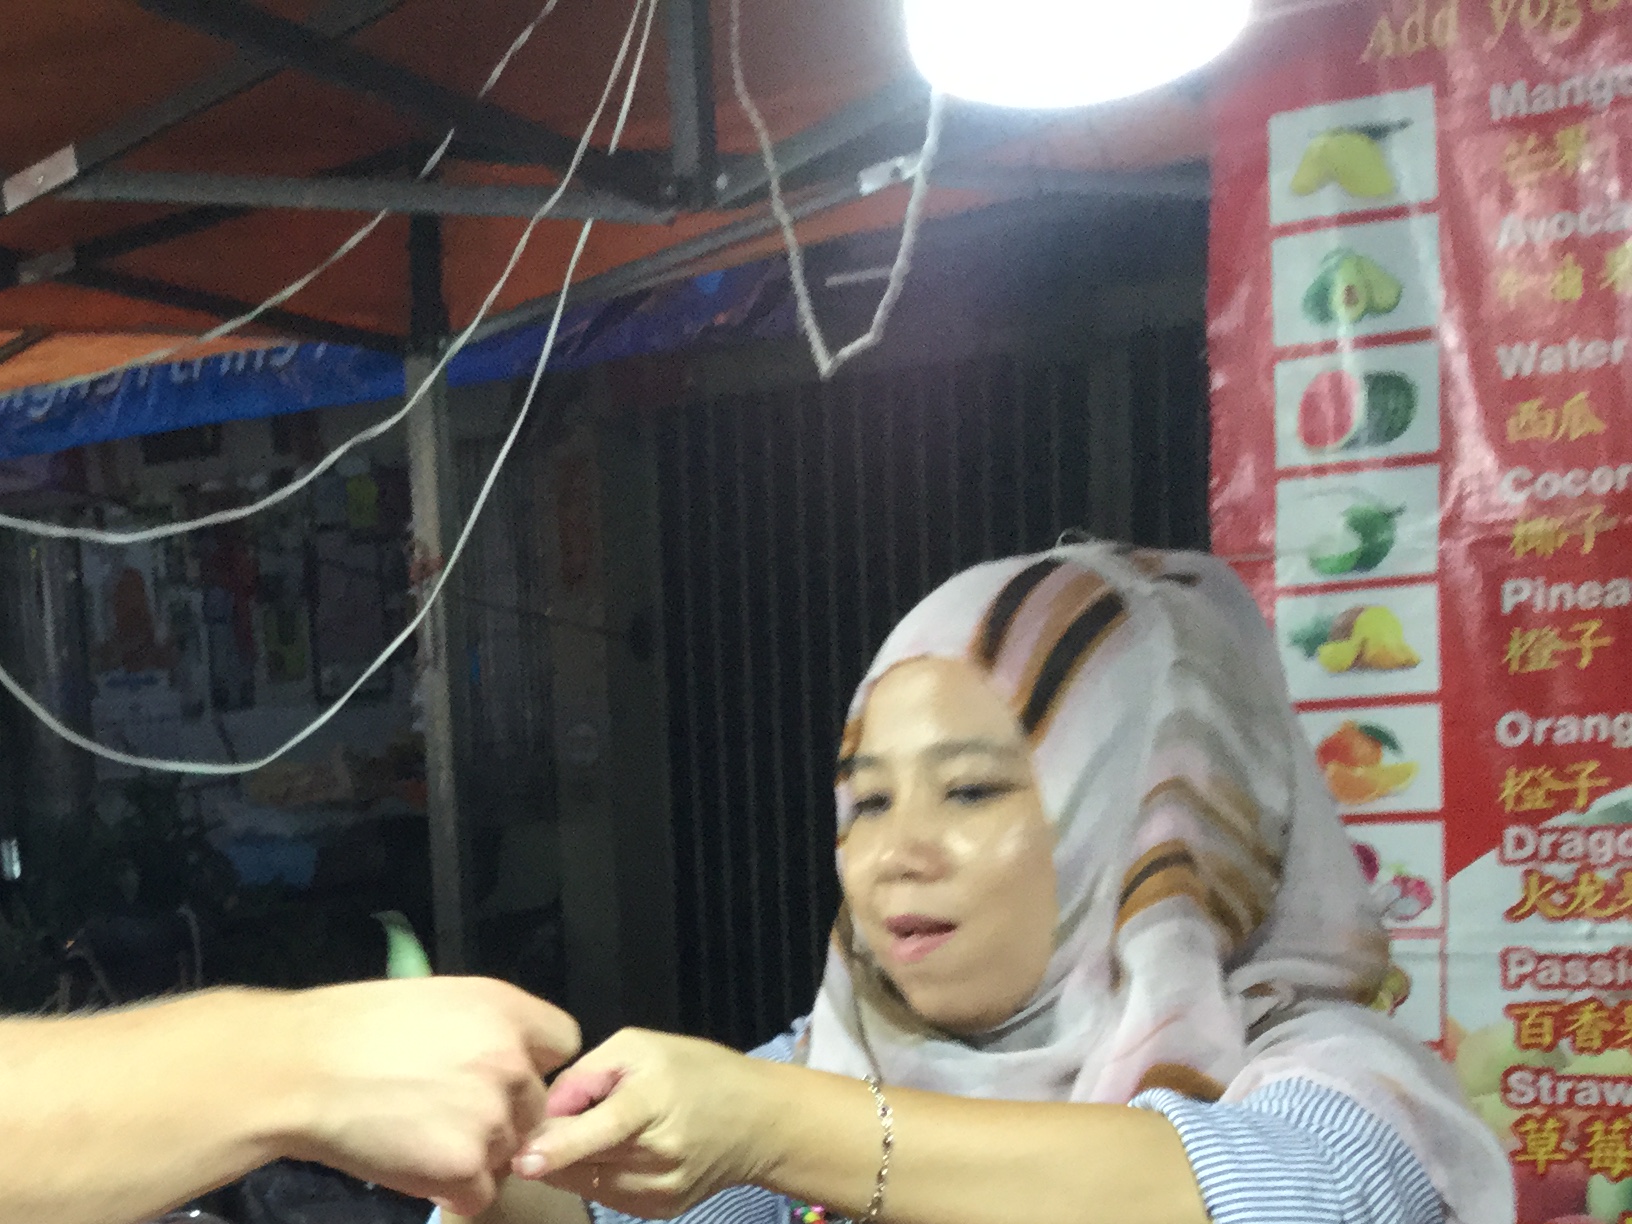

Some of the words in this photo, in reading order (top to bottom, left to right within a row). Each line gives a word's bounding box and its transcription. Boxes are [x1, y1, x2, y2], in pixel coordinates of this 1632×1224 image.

[1360, 2, 1460, 60] Add
[1496, 336, 1630, 380] Water
[1494, 709, 1632, 750] Orang
[1504, 948, 1632, 987] Passi
